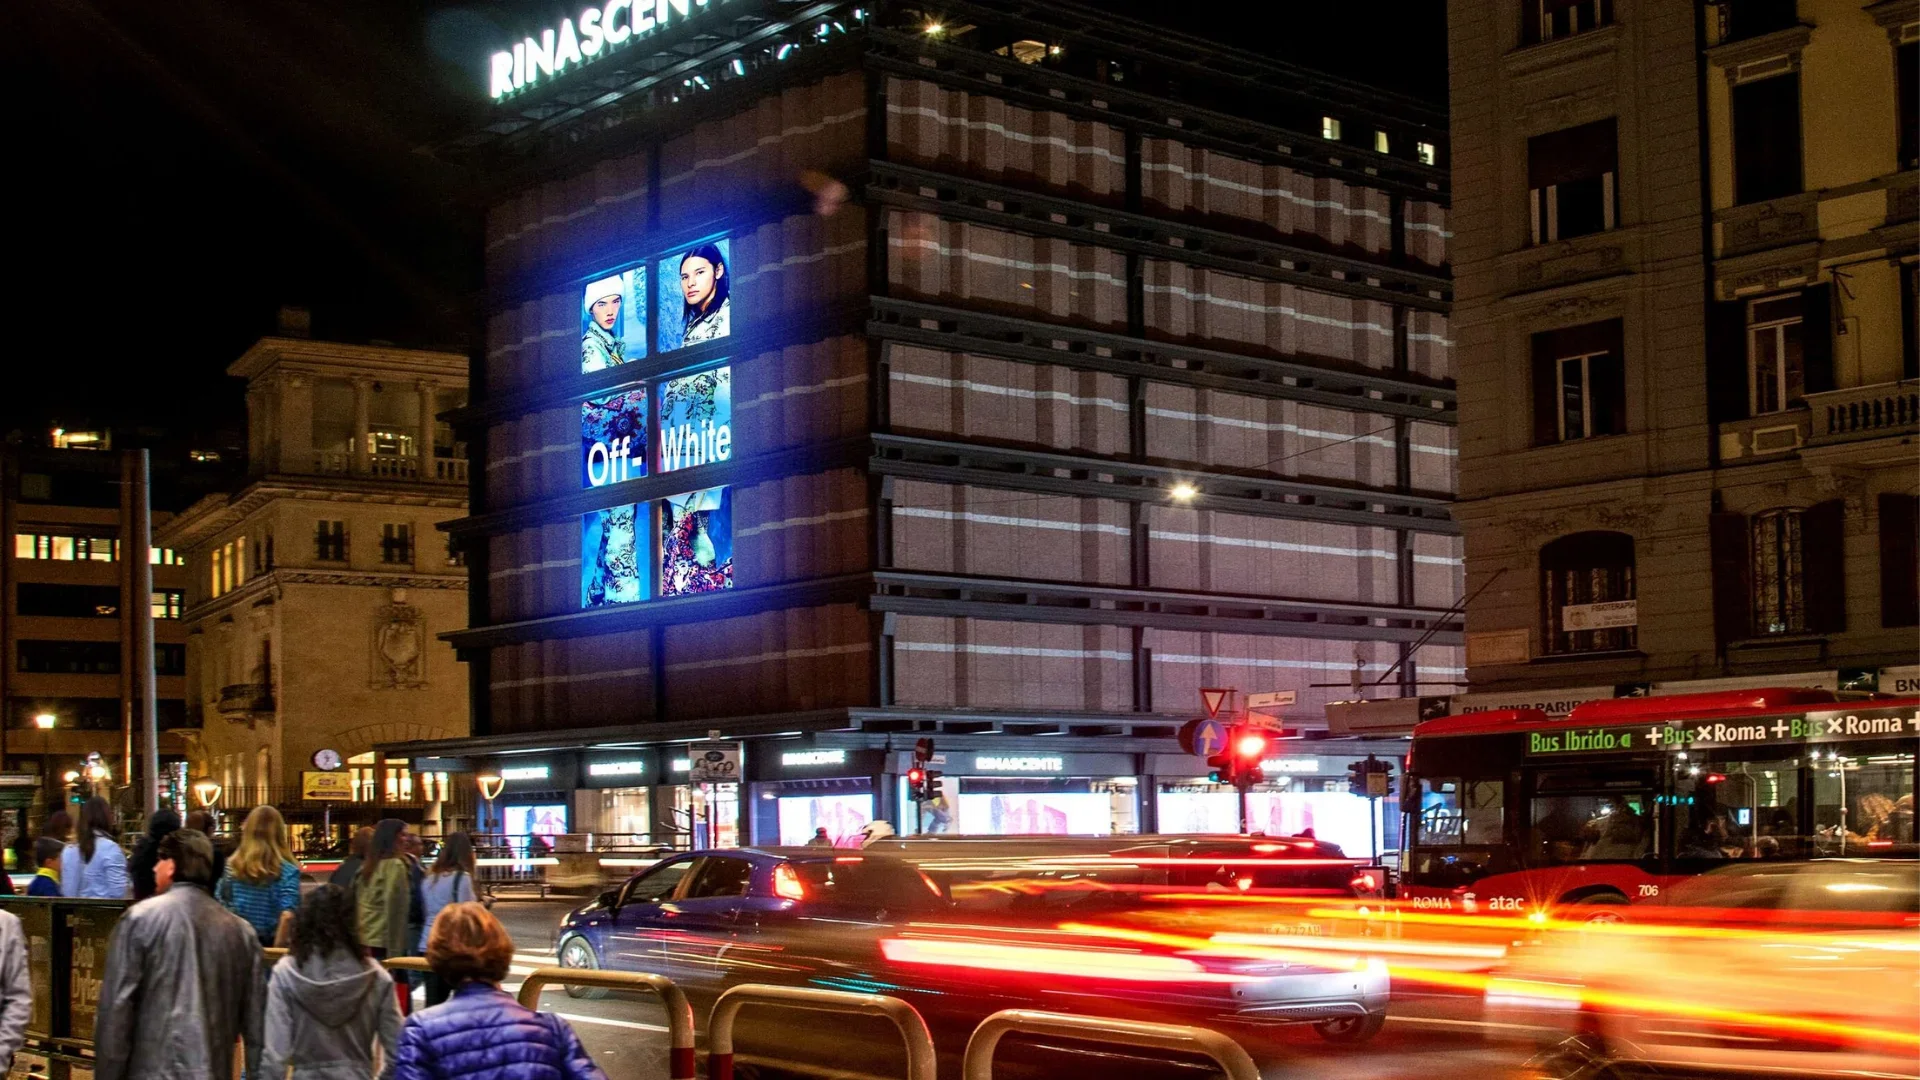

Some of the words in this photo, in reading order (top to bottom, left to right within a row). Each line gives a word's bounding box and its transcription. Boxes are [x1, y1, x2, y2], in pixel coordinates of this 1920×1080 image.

[490, 0, 707, 99] RINASCEN
[588, 435, 642, 487] Off-
[660, 419, 731, 474] White
[1531, 733, 1559, 753] Bus
[1565, 729, 1615, 751] Ibrido
[1638, 884, 1659, 896] 706
[1413, 896, 1452, 910] ROMA
[1489, 896, 1524, 910] atac
